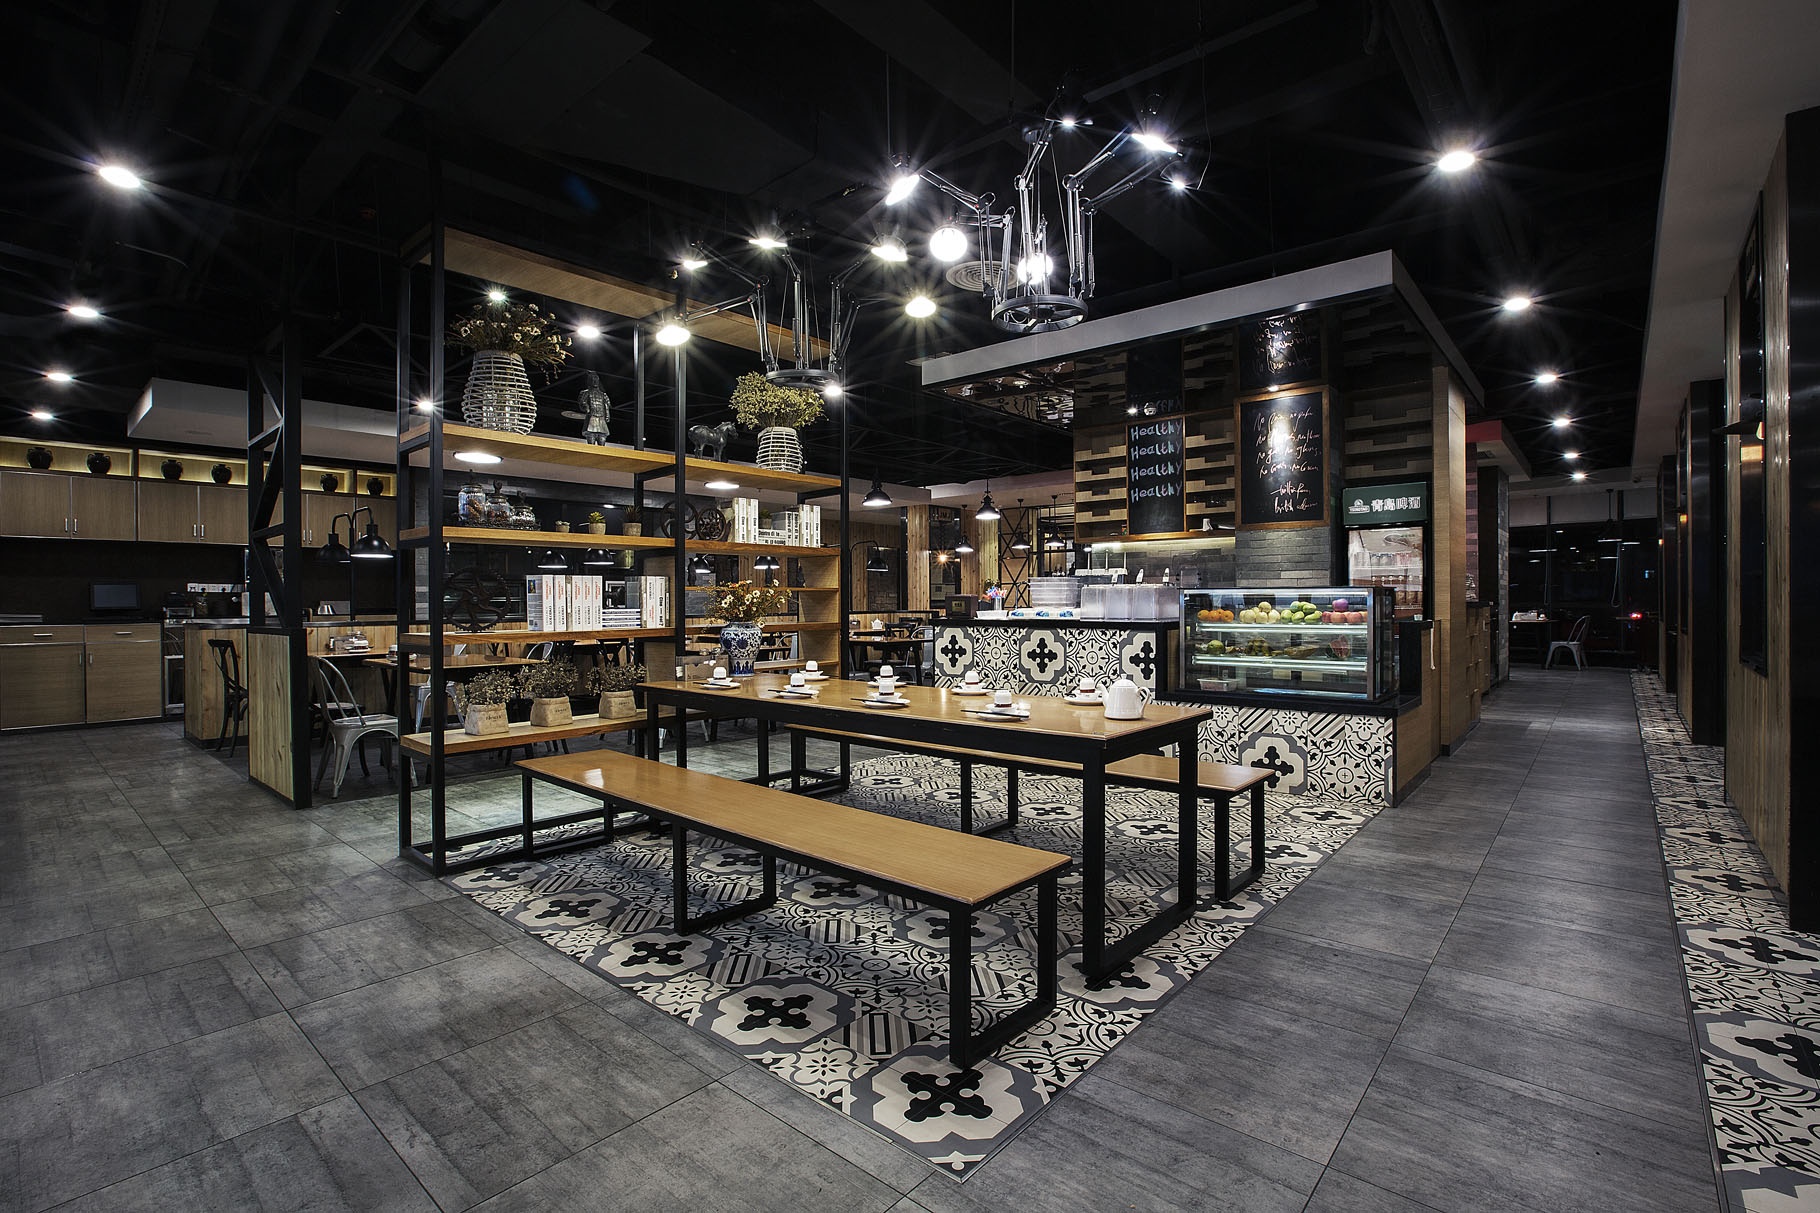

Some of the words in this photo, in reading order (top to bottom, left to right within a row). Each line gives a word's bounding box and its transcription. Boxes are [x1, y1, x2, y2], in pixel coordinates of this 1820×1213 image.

[1130, 420, 1182, 441] Healthy
[1130, 440, 1182, 461] Healthy
[1130, 460, 1182, 482] Healthy
[1130, 481, 1182, 503] Healthy
